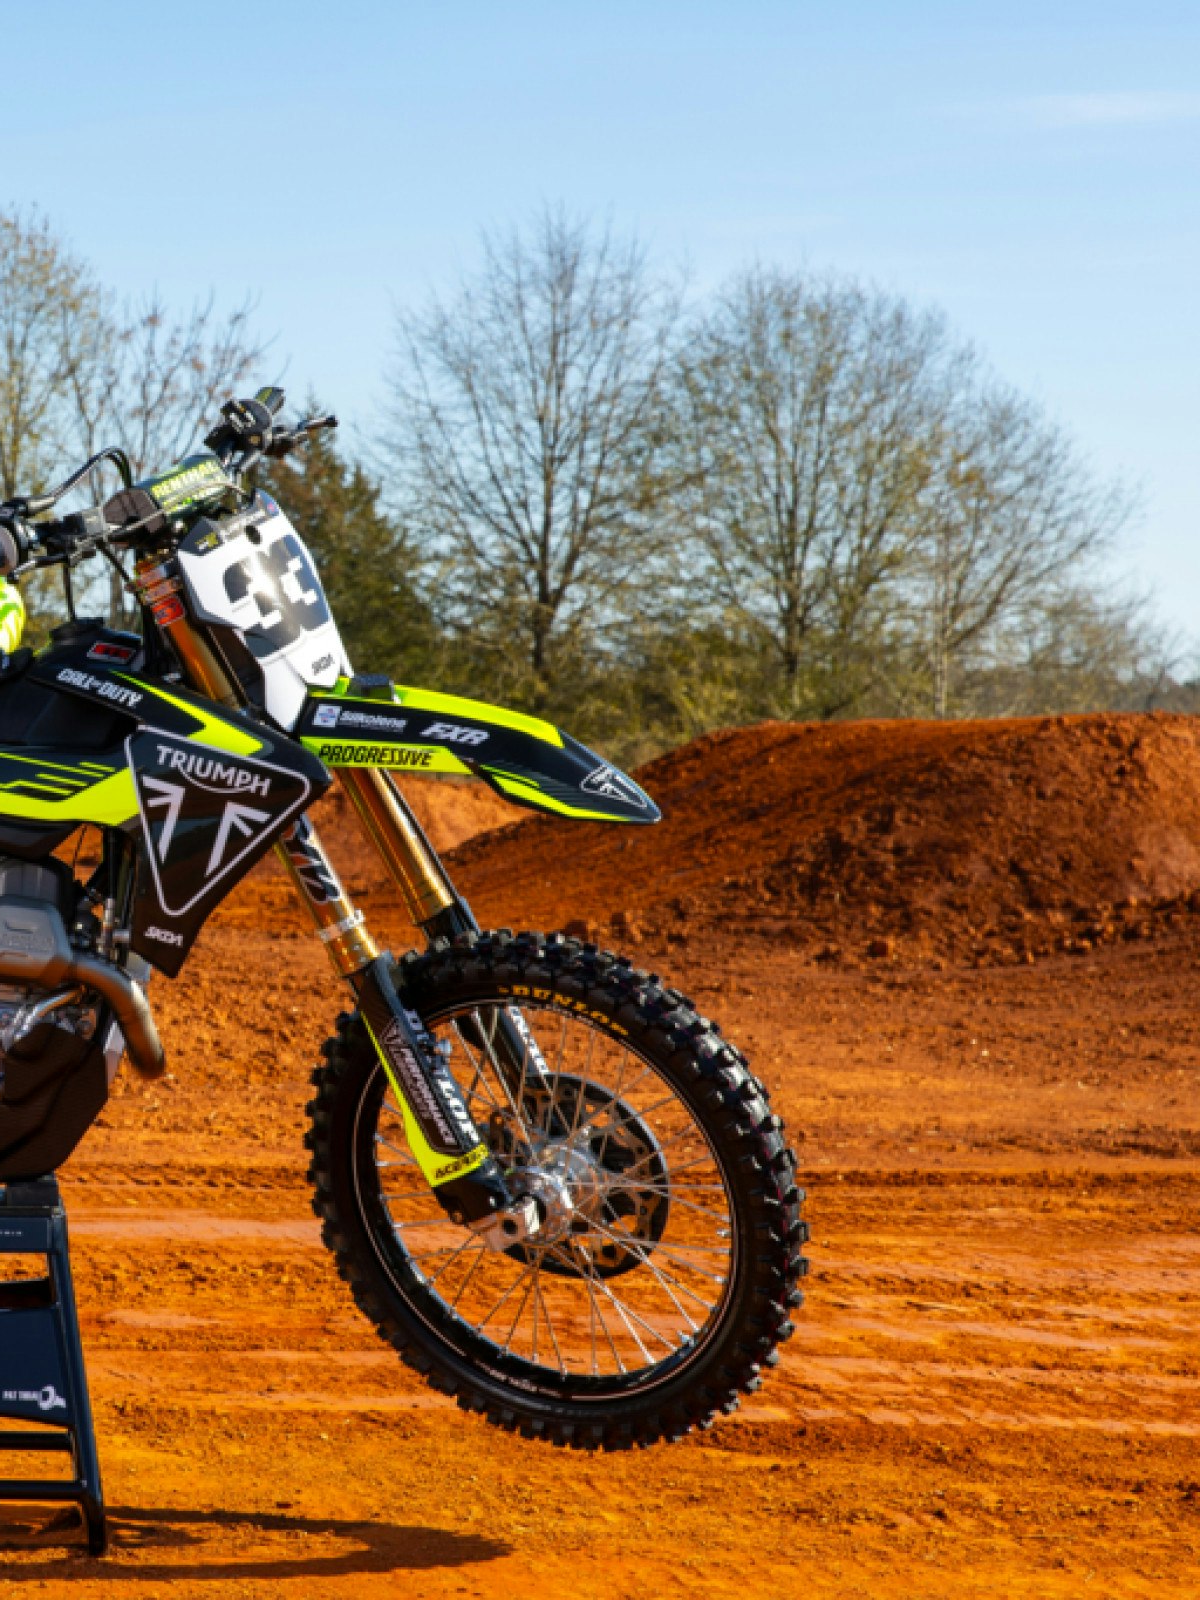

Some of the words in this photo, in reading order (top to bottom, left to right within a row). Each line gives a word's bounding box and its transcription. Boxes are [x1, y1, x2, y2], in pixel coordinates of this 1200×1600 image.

[223, 534, 330, 657] 33
[56, 667, 90, 691] CALL
[97, 680, 143, 707] DUTY
[420, 721, 489, 745] FXR
[157, 745, 272, 797] TRIUMPH
[318, 743, 432, 767] PROGRESSIVE
